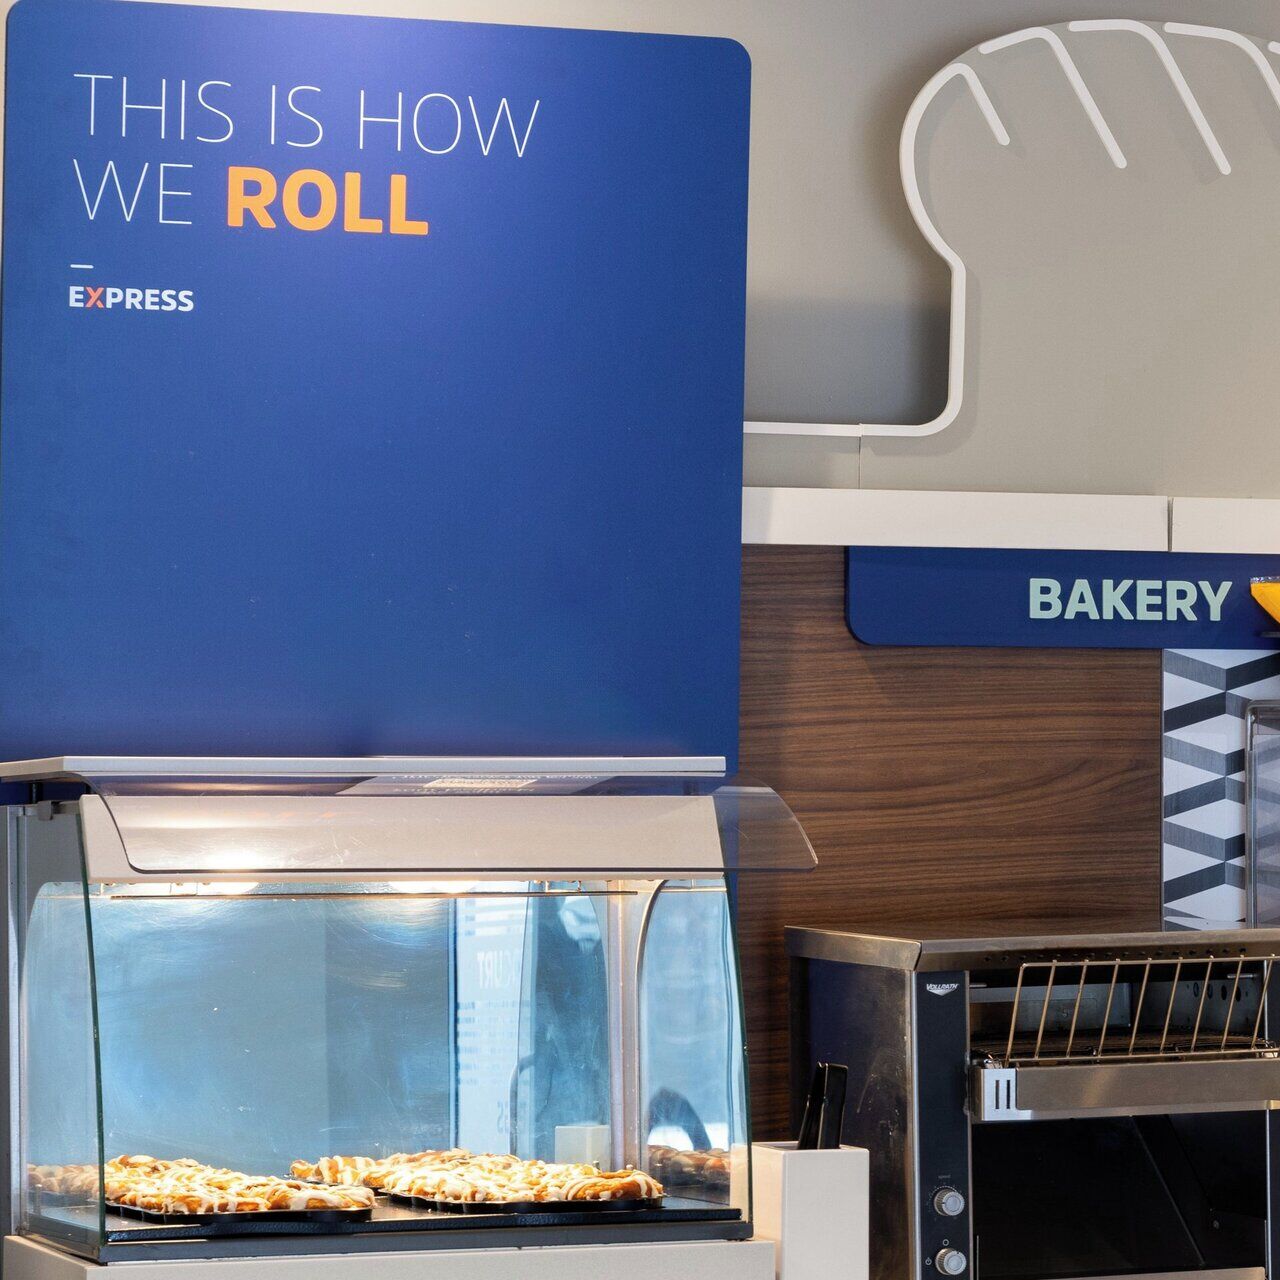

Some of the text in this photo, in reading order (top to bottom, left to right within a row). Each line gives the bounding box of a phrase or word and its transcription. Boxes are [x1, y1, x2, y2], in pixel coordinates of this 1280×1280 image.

[73, 73, 539, 158] THIS IS HOW
[73, 158, 429, 236] WE ROLL
[69, 285, 194, 312] EXPRESS
[1029, 578, 1233, 622] BAKERY
